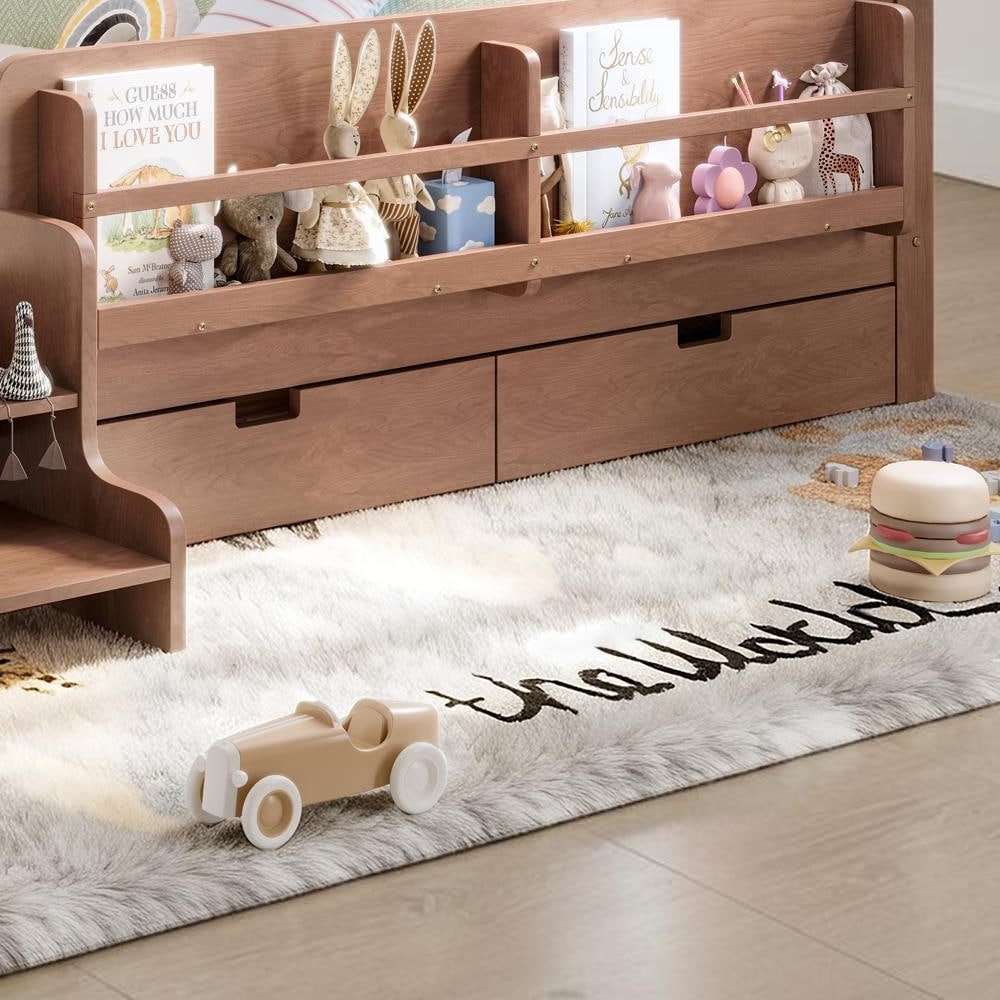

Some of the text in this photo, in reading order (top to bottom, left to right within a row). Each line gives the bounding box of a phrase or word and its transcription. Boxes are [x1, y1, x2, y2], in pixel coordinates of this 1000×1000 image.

[599, 28, 654, 70] Sense
[125, 82, 177, 104] GUESS
[588, 70, 664, 120] Sensibility
[104, 101, 198, 127] HOW MUCH
[101, 121, 201, 151] I LOVE YOU
[133, 288, 149, 297] Anita
